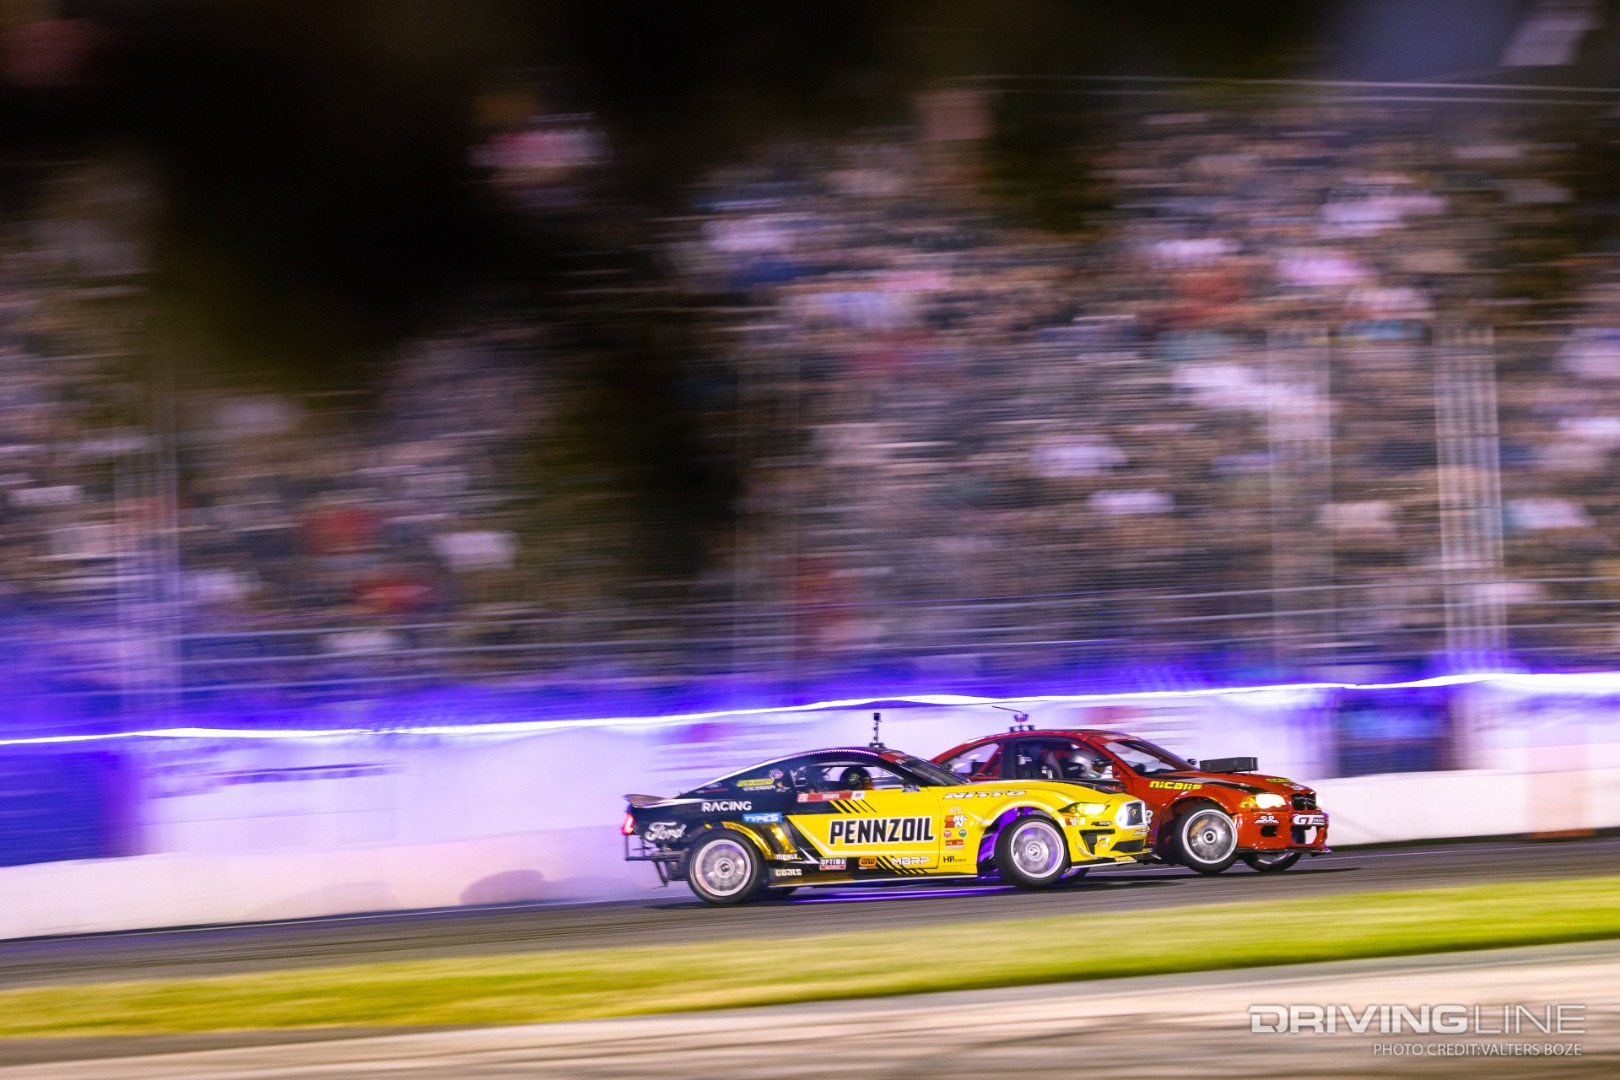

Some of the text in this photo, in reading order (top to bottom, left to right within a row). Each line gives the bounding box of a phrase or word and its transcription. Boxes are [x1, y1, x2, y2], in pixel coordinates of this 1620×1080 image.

[943, 790, 1027, 799] NITTO
[701, 801, 752, 812] RACING
[645, 822, 687, 841] Ford
[829, 817, 936, 846] PENNZOIL
[821, 858, 846, 866] OPTIMA
[892, 857, 930, 865] MBRP
